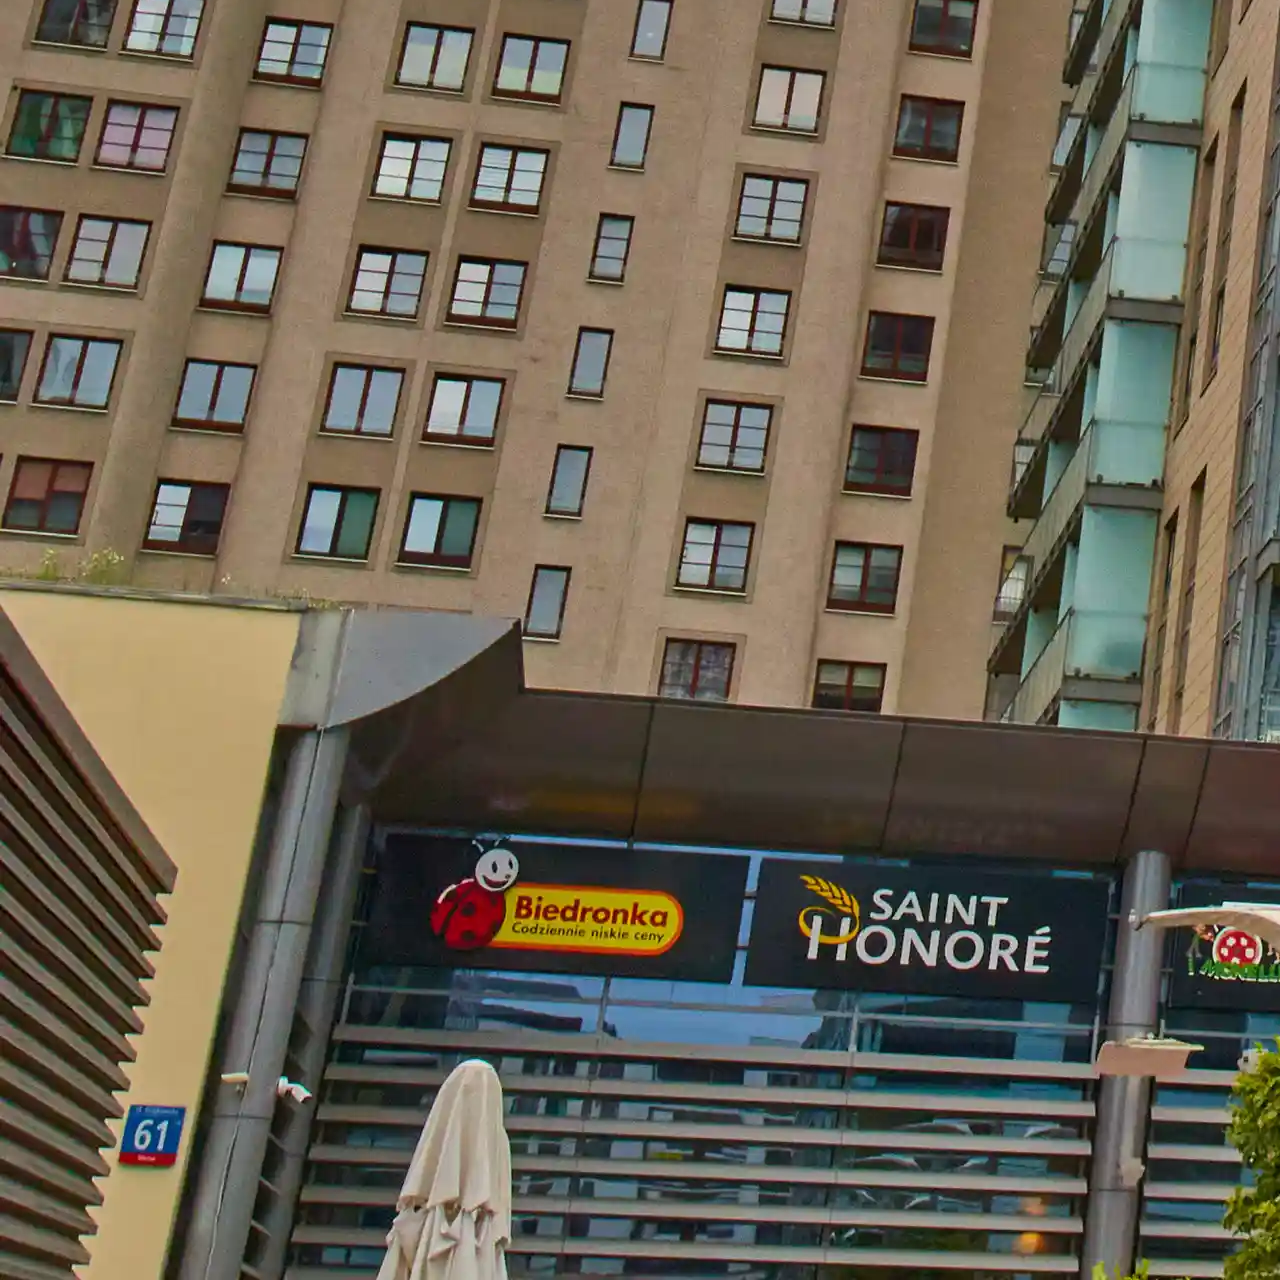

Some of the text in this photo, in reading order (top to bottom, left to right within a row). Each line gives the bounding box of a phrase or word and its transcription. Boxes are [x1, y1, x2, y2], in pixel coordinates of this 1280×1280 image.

[514, 896, 668, 928] Biedronka
[870, 888, 1009, 927] SAINT
[511, 922, 665, 944] Codziennie niskie ceny
[807, 915, 1051, 974] HONORÉ
[133, 1119, 169, 1152] 61
